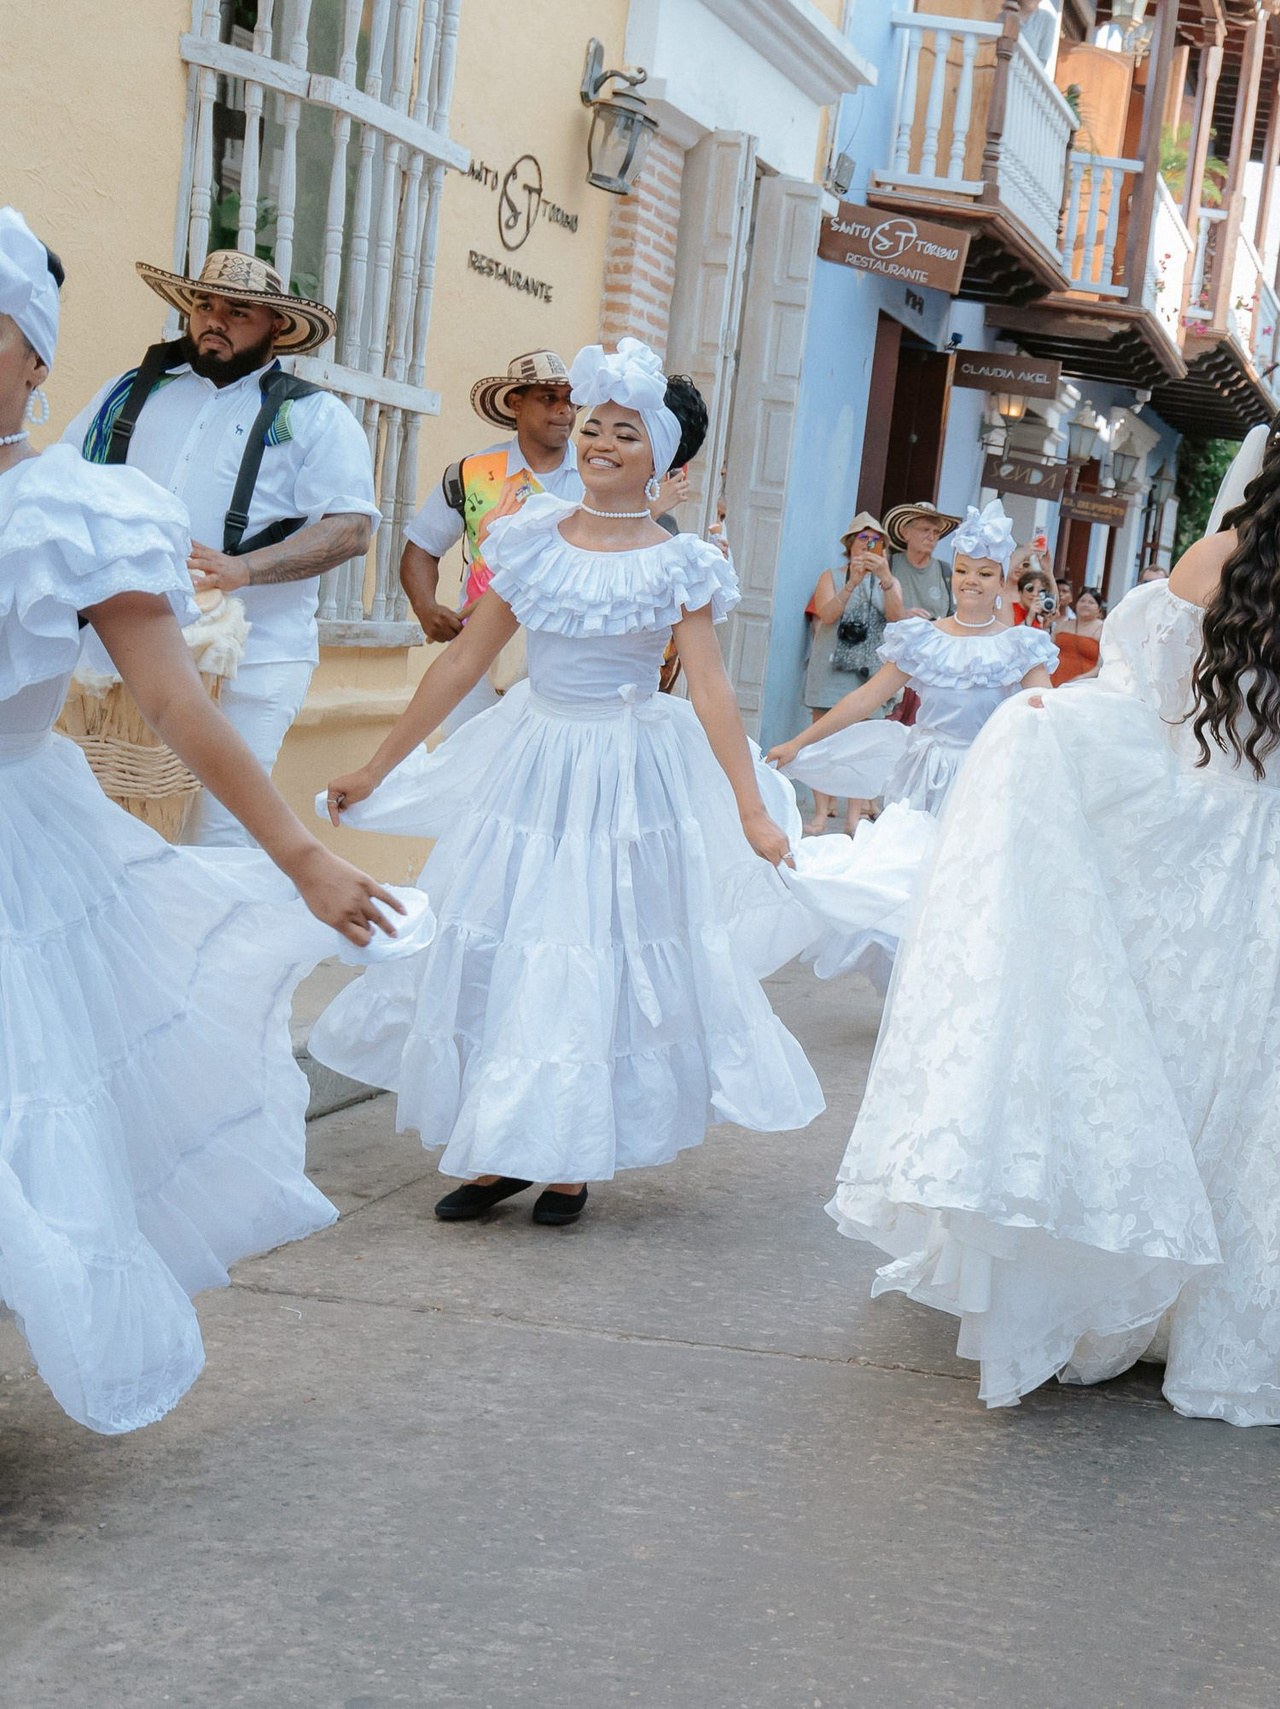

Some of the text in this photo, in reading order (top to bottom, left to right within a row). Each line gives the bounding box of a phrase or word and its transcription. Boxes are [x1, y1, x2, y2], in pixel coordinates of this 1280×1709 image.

[467, 158, 498, 192] ANTO
[830, 216, 871, 239] SANTO
[468, 249, 554, 304] RESTAURANTE
[844, 252, 929, 284] RESTAURANTE
[961, 363, 1051, 384] CLAUDIA AKEL
